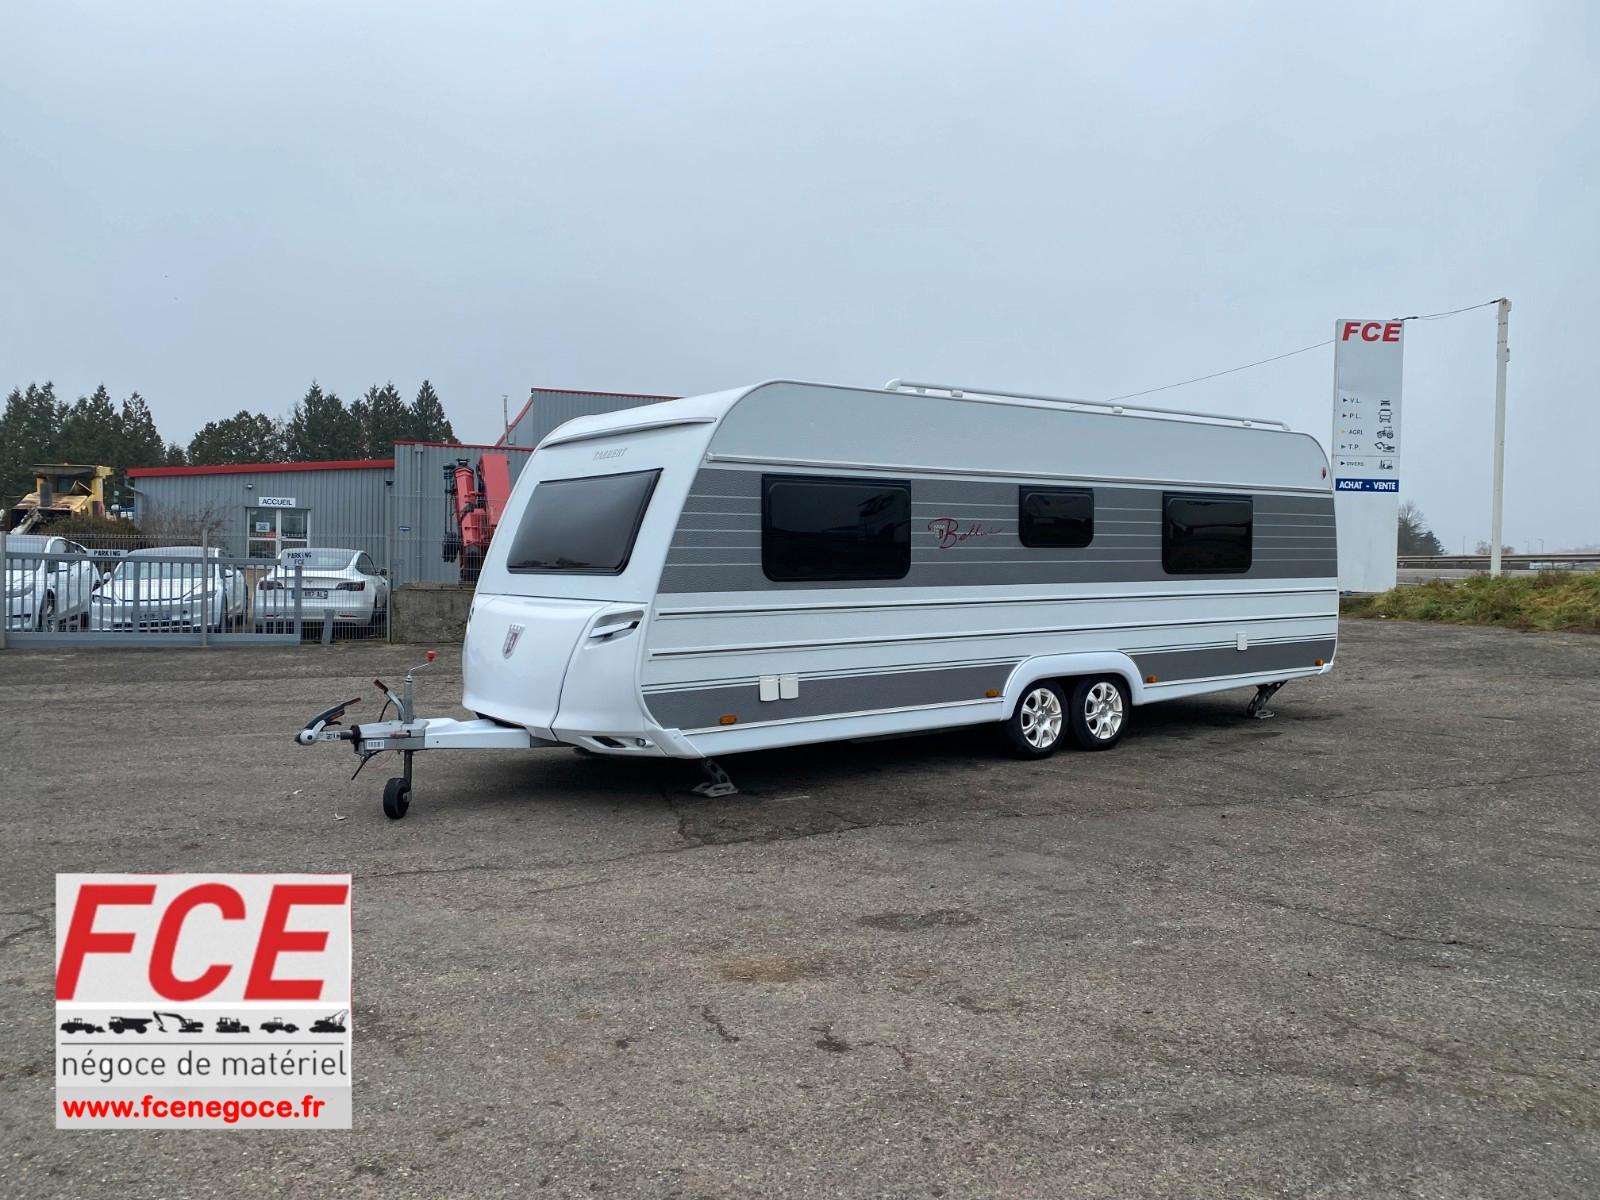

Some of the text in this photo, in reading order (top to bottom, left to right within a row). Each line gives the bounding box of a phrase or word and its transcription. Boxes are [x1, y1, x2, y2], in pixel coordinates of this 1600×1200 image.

[1342, 322, 1402, 342] FCE
[1339, 481, 1363, 489] ACHAT
[1373, 482, 1396, 490] VENTE
[262, 498, 292, 506] ACCUEIL
[287, 551, 312, 559] PARKING
